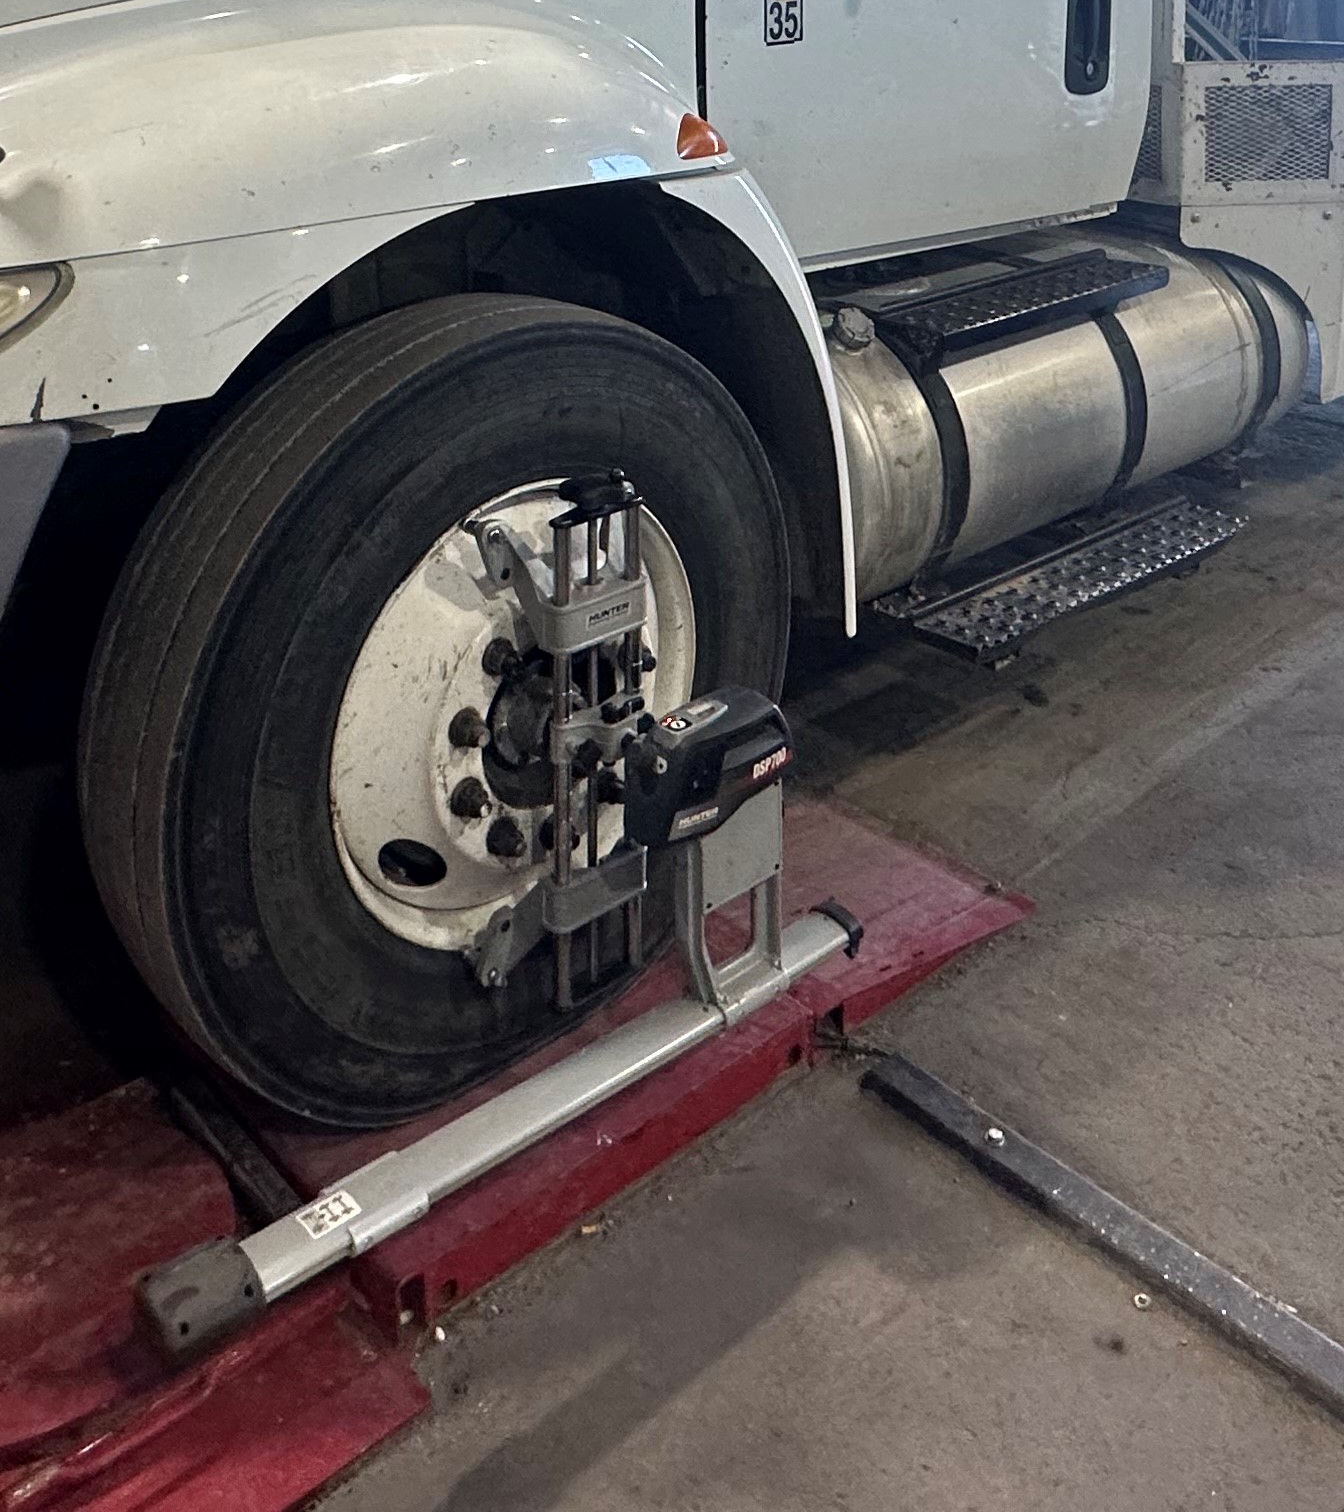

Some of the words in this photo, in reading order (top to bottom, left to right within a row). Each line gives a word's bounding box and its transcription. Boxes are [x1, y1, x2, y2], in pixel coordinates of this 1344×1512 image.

[769, 0, 799, 41] 35
[588, 601, 630, 624] HUNTER
[753, 746, 787, 779] DSP700
[678, 807, 719, 826] HUNTER
